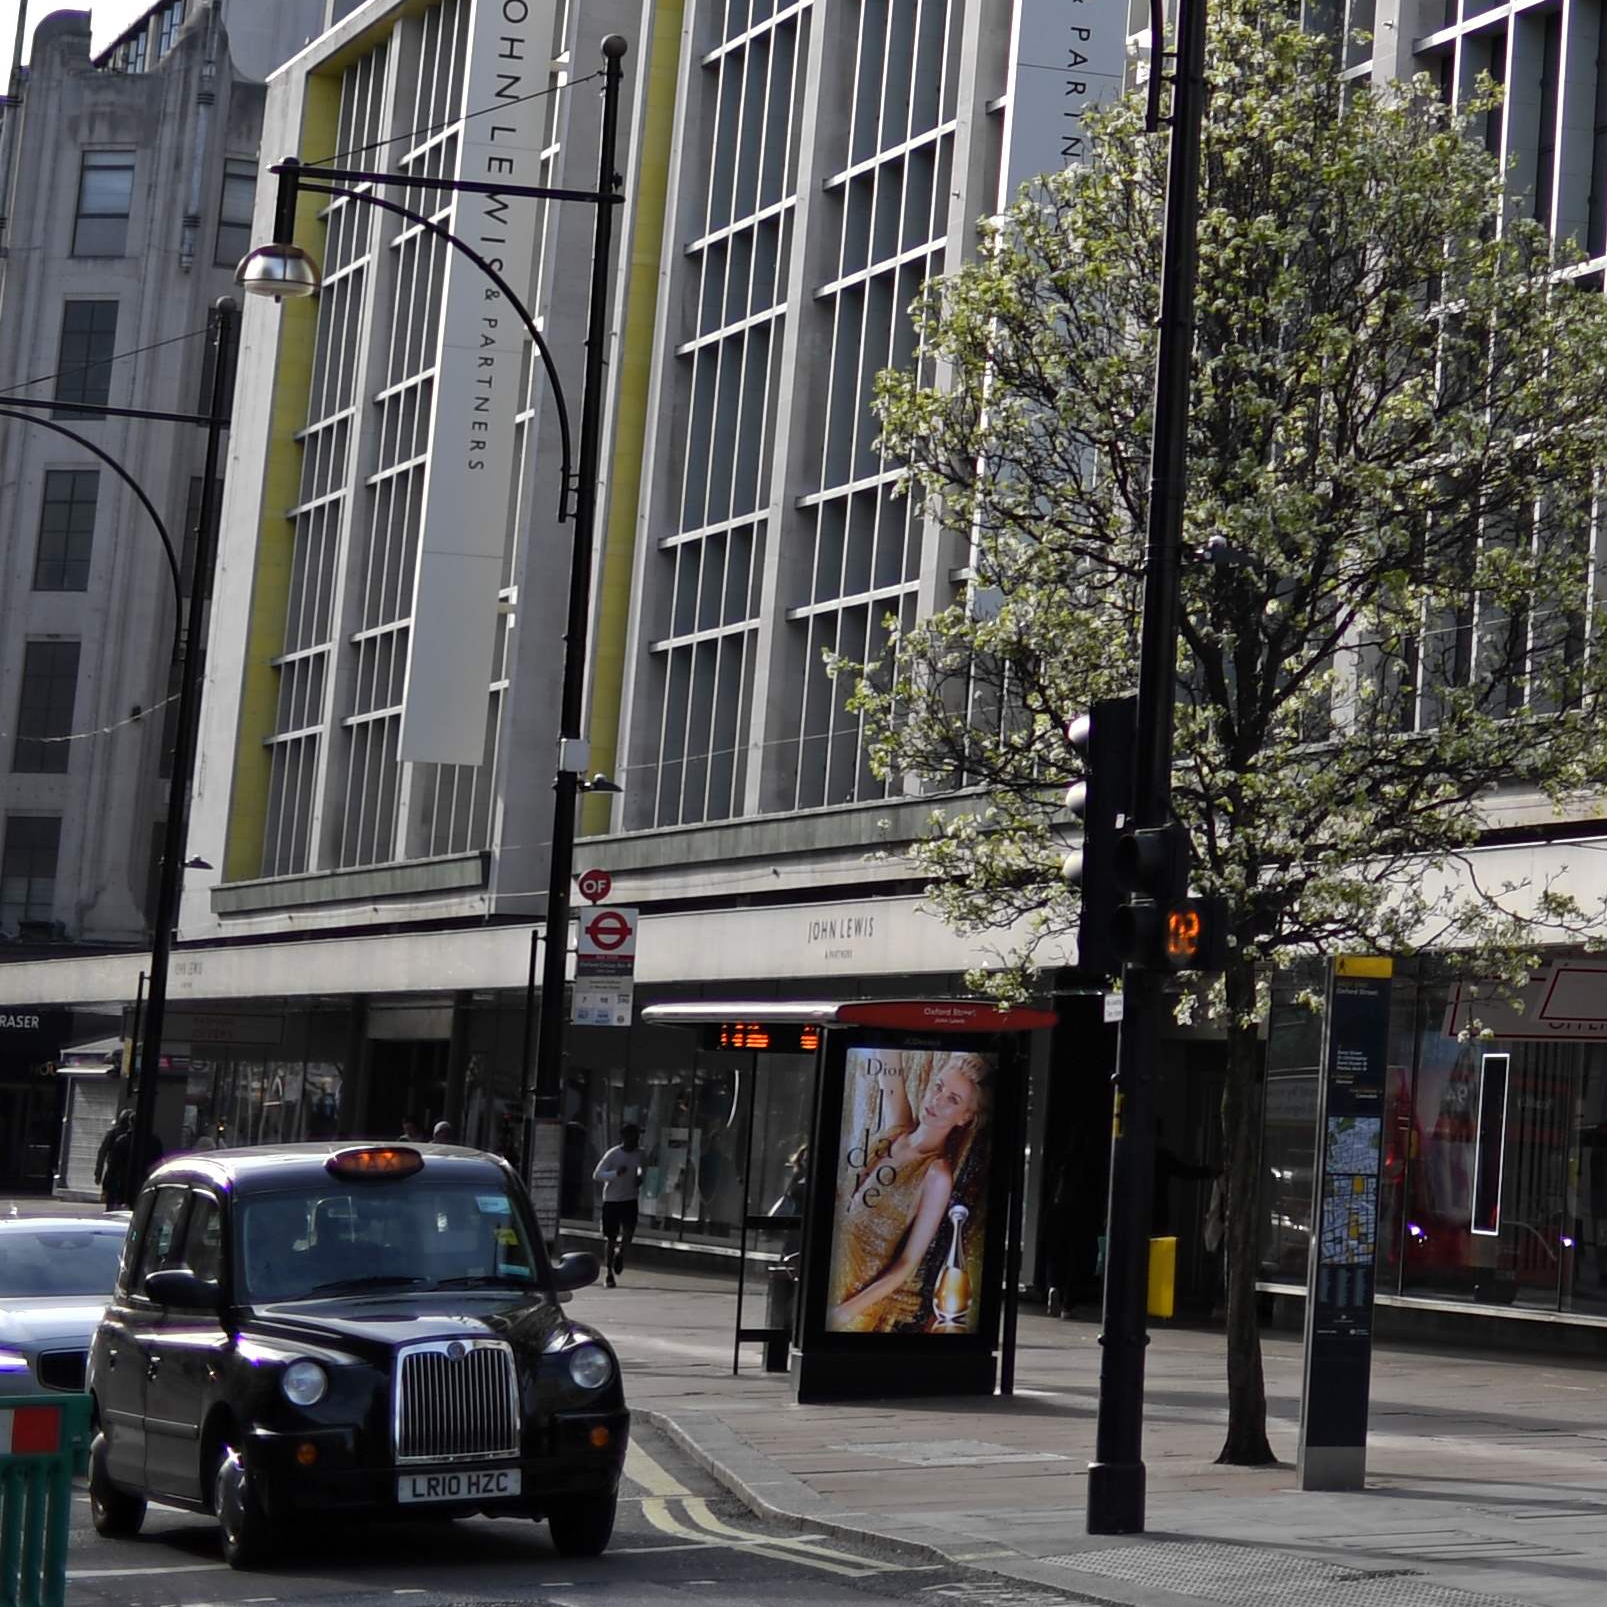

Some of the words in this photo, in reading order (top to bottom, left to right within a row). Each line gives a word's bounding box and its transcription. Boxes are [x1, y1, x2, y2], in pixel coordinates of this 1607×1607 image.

[484, 288, 500, 301] &
[468, 317, 498, 471] PARTNERS
[583, 879, 607, 894] OF
[807, 921, 837, 944] JOHN
[840, 916, 875, 939] LEWIS
[923, 1007, 951, 1016] Oxford
[866, 1057, 903, 1077] Dior
[412, 1475, 461, 1499] LR10
[467, 1471, 509, 1496] HZC
